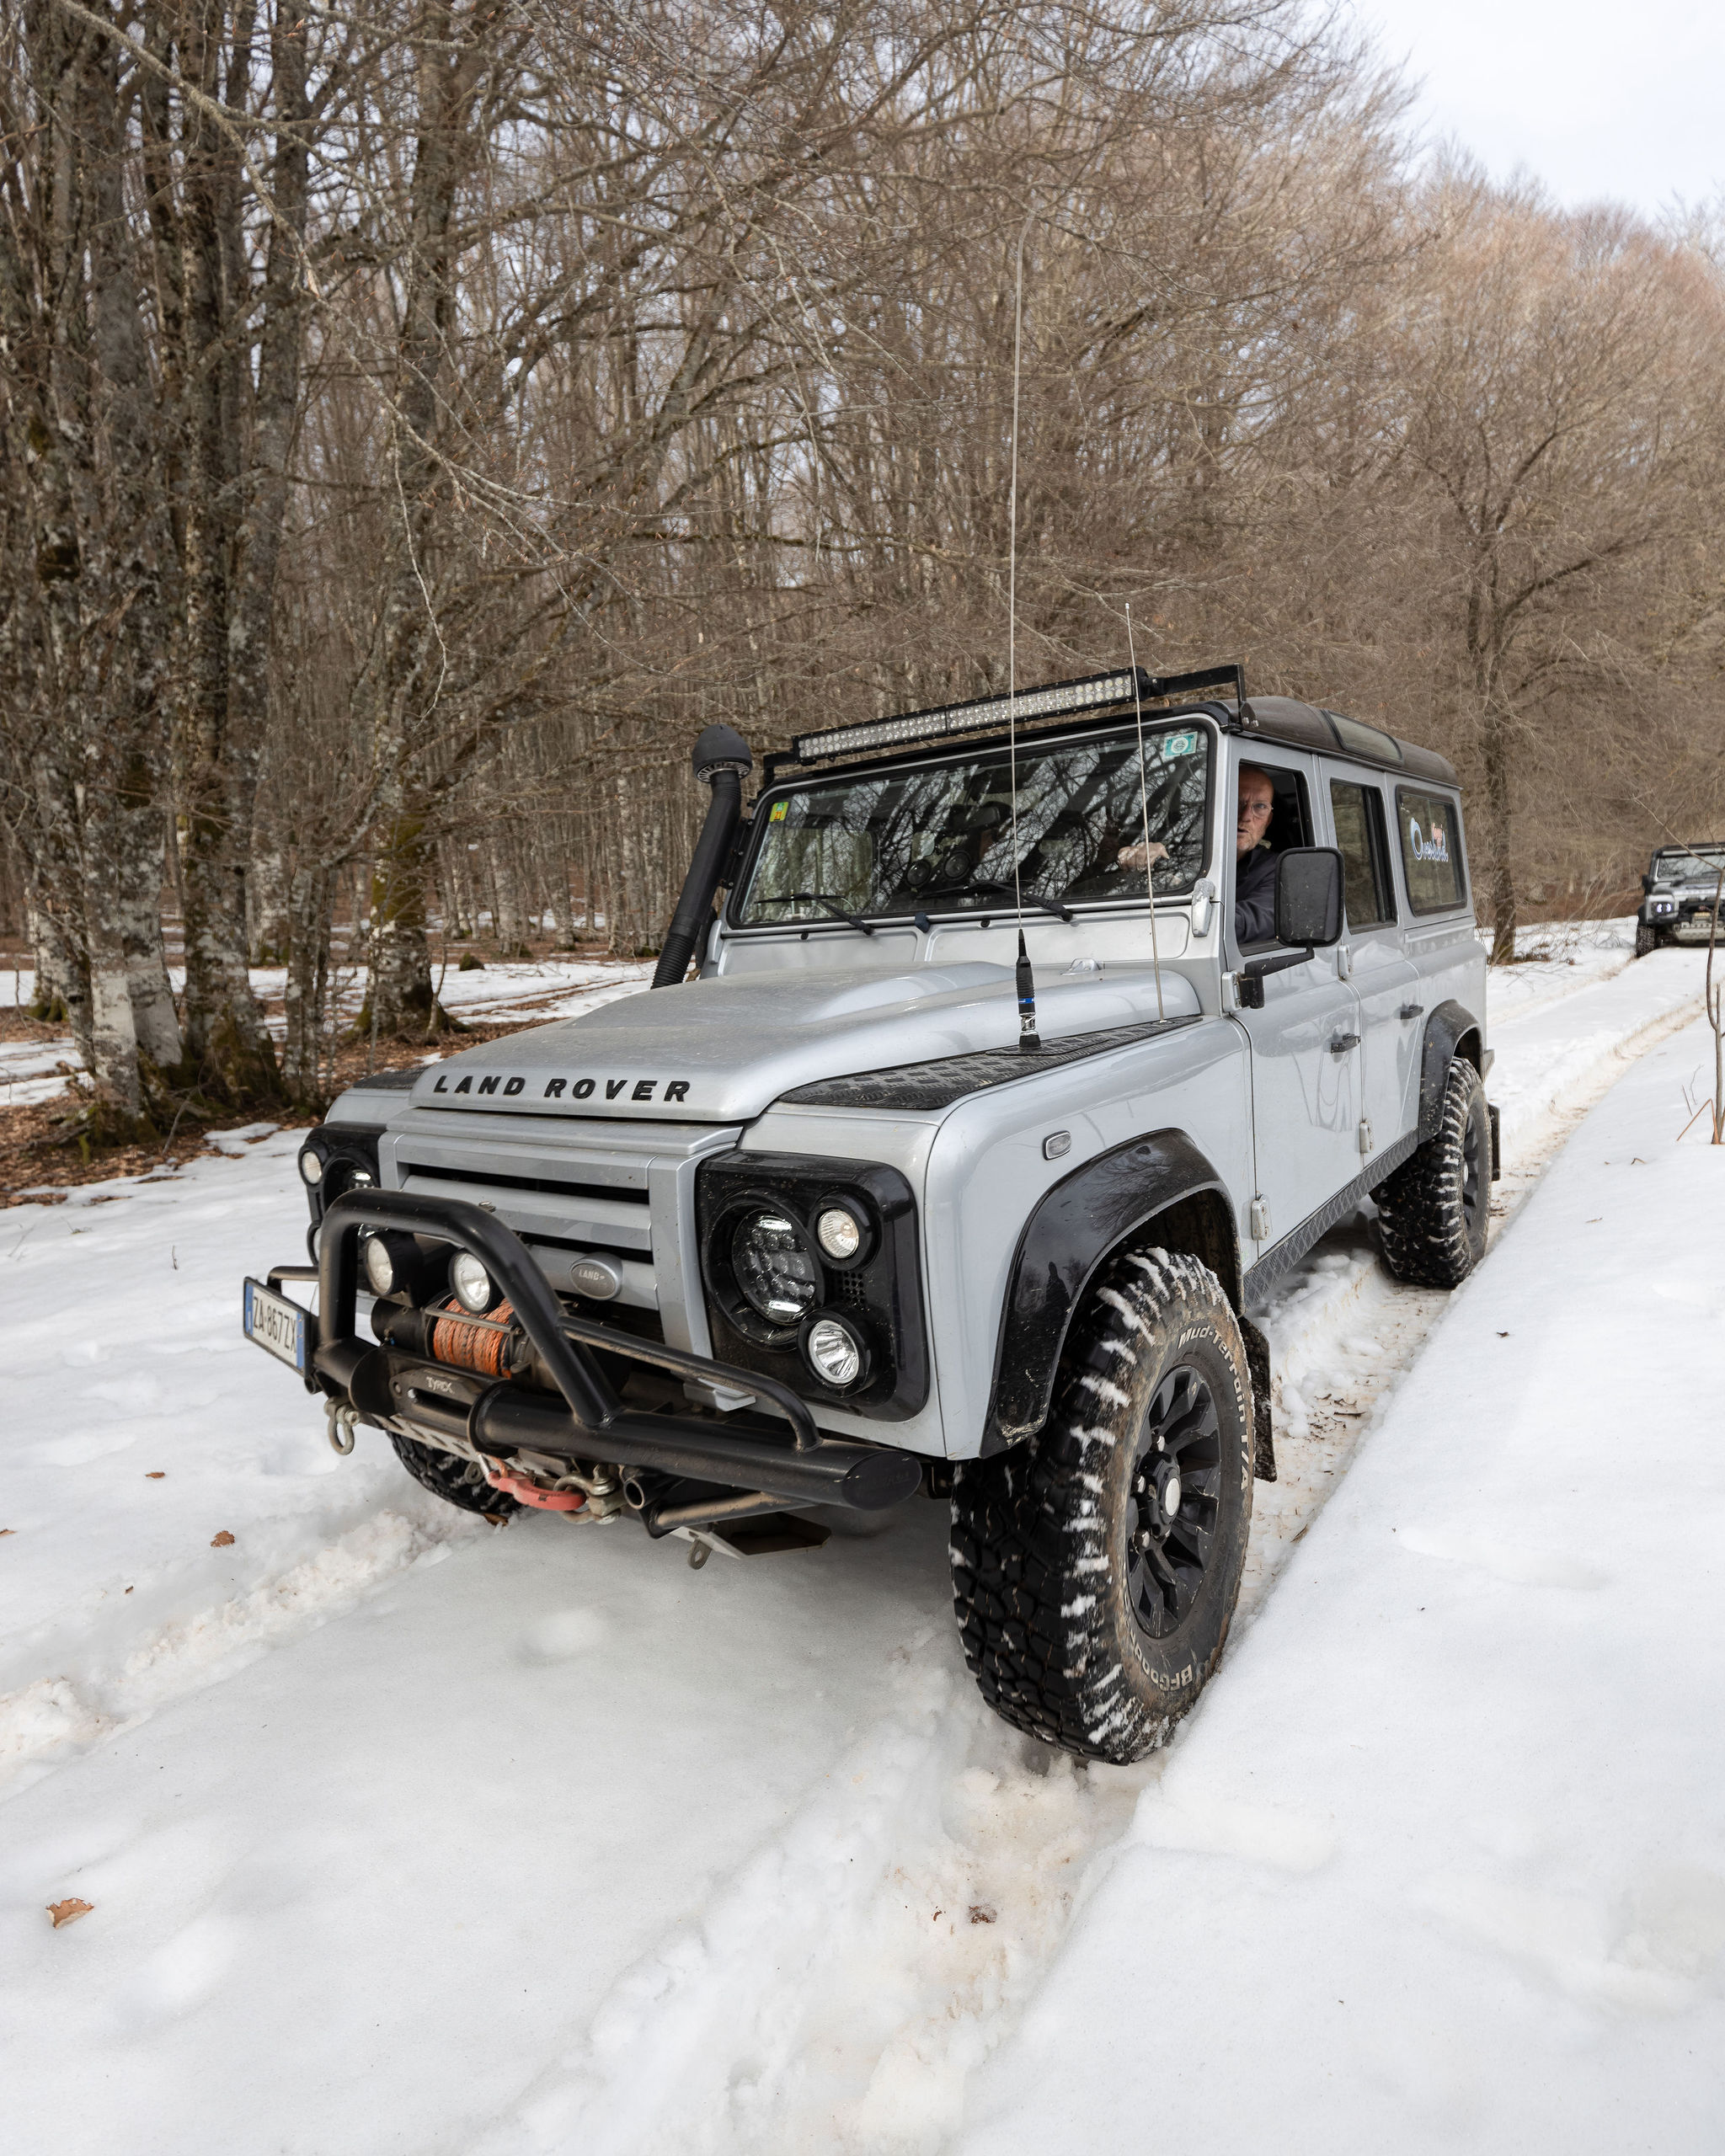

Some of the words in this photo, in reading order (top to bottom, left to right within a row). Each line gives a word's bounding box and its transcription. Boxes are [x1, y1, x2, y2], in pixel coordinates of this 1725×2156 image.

[433, 1075, 526, 1096] LAND
[544, 1078, 691, 1102] ROVER
[1178, 1326, 1247, 1423] Mud-Terrain
